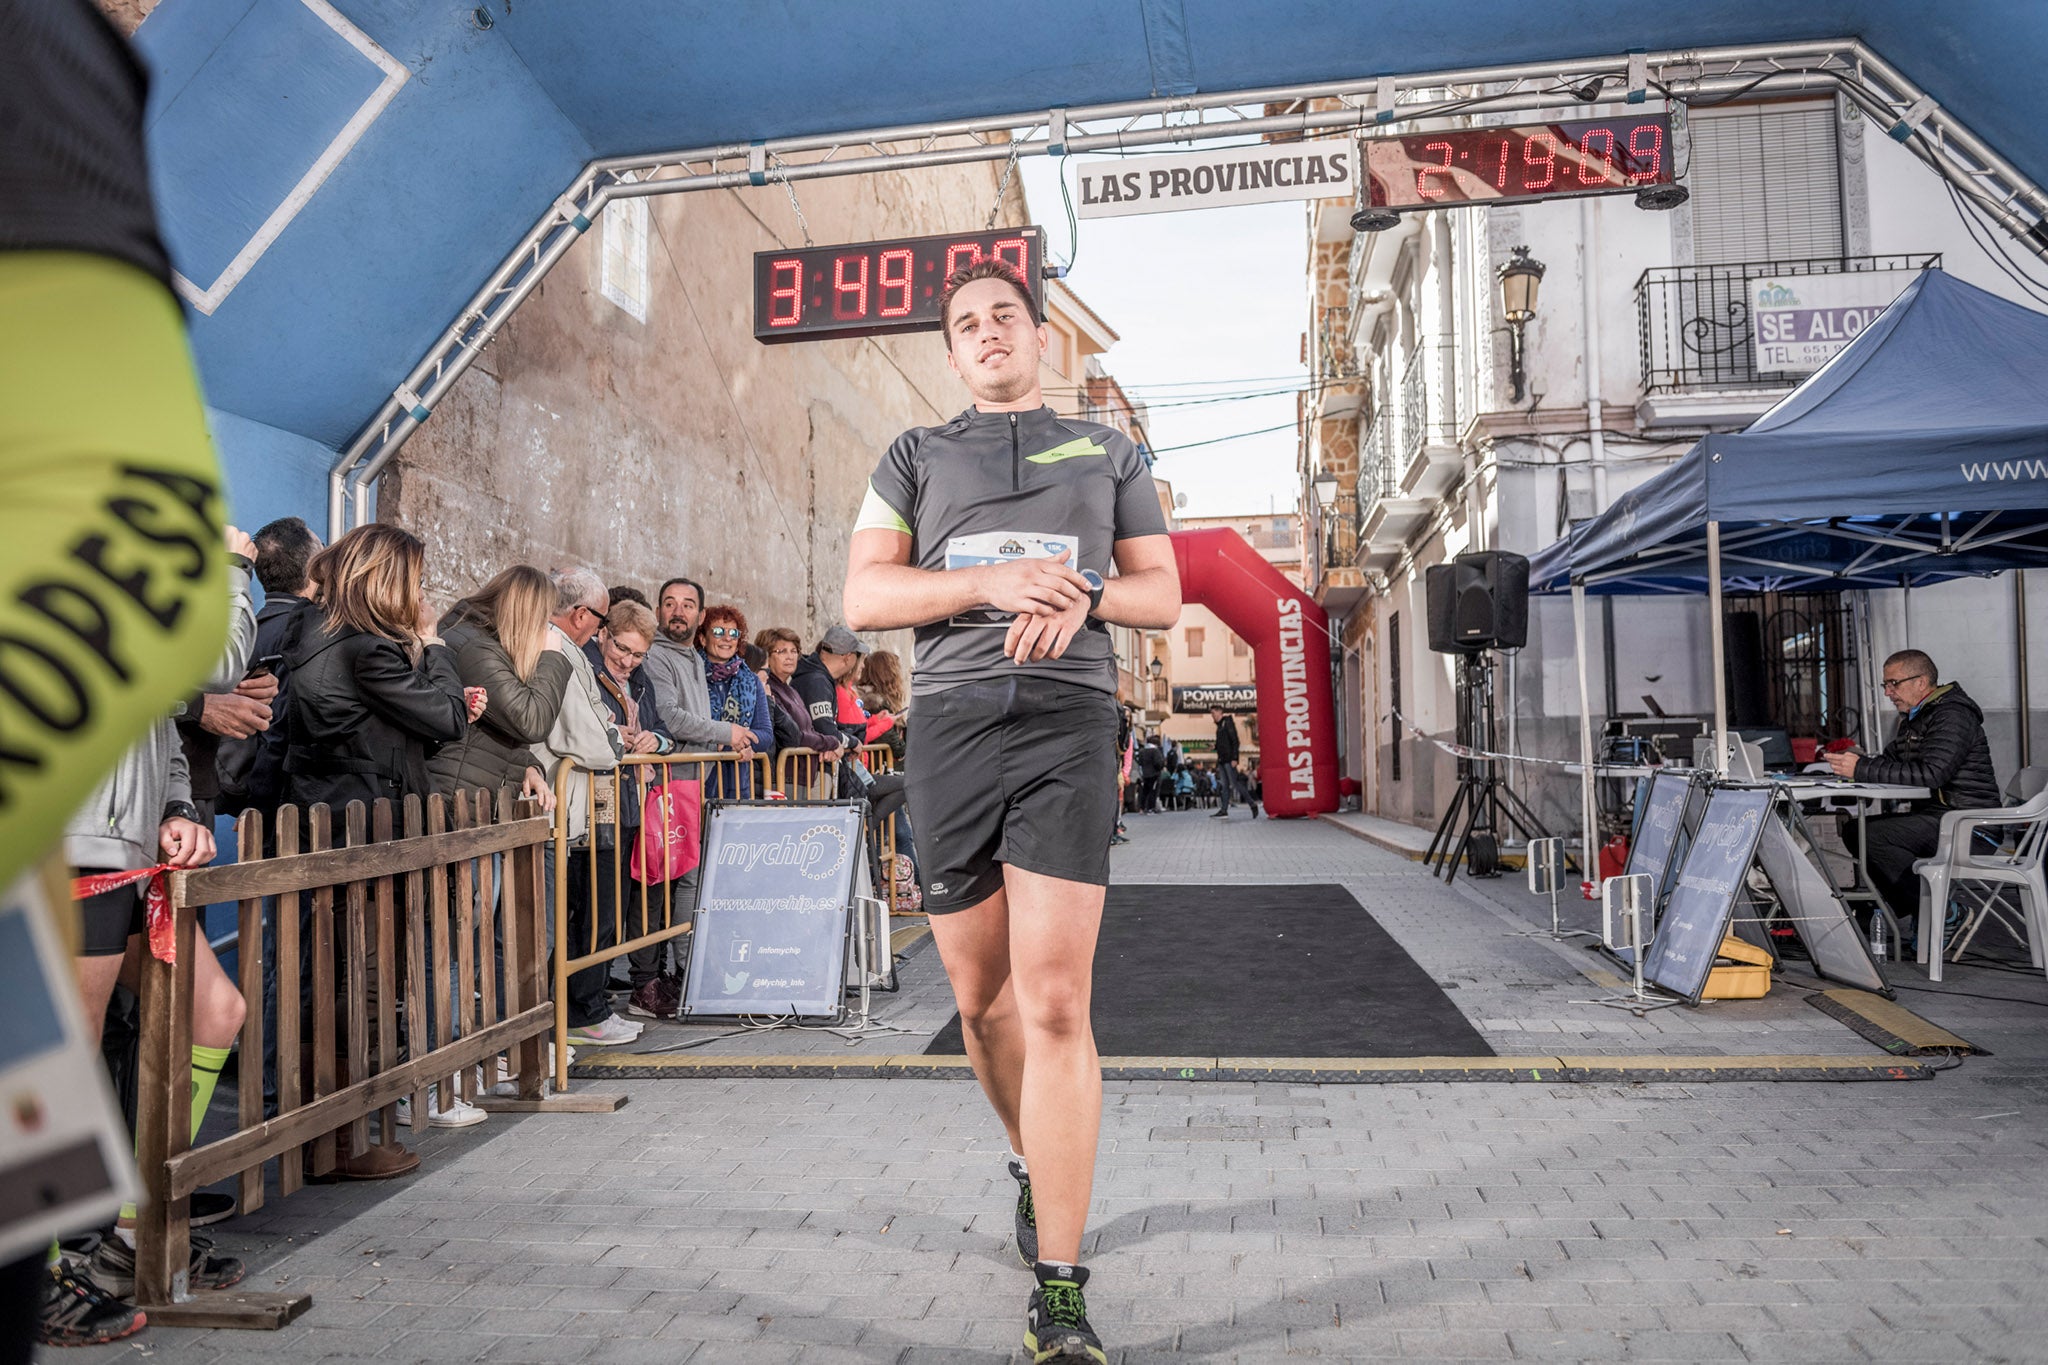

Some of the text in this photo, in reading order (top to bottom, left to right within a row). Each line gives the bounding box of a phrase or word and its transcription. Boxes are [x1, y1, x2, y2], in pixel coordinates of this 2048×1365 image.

[1081, 153, 1349, 205] LAS PROVINCIAS
[1417, 124, 1663, 198] 2:19:09
[1761, 312, 1796, 341] SE
[1277, 598, 1315, 800] LAS PROVINCIAS
[718, 834, 825, 873] mychip
[711, 895, 837, 915] www.mychip.es
